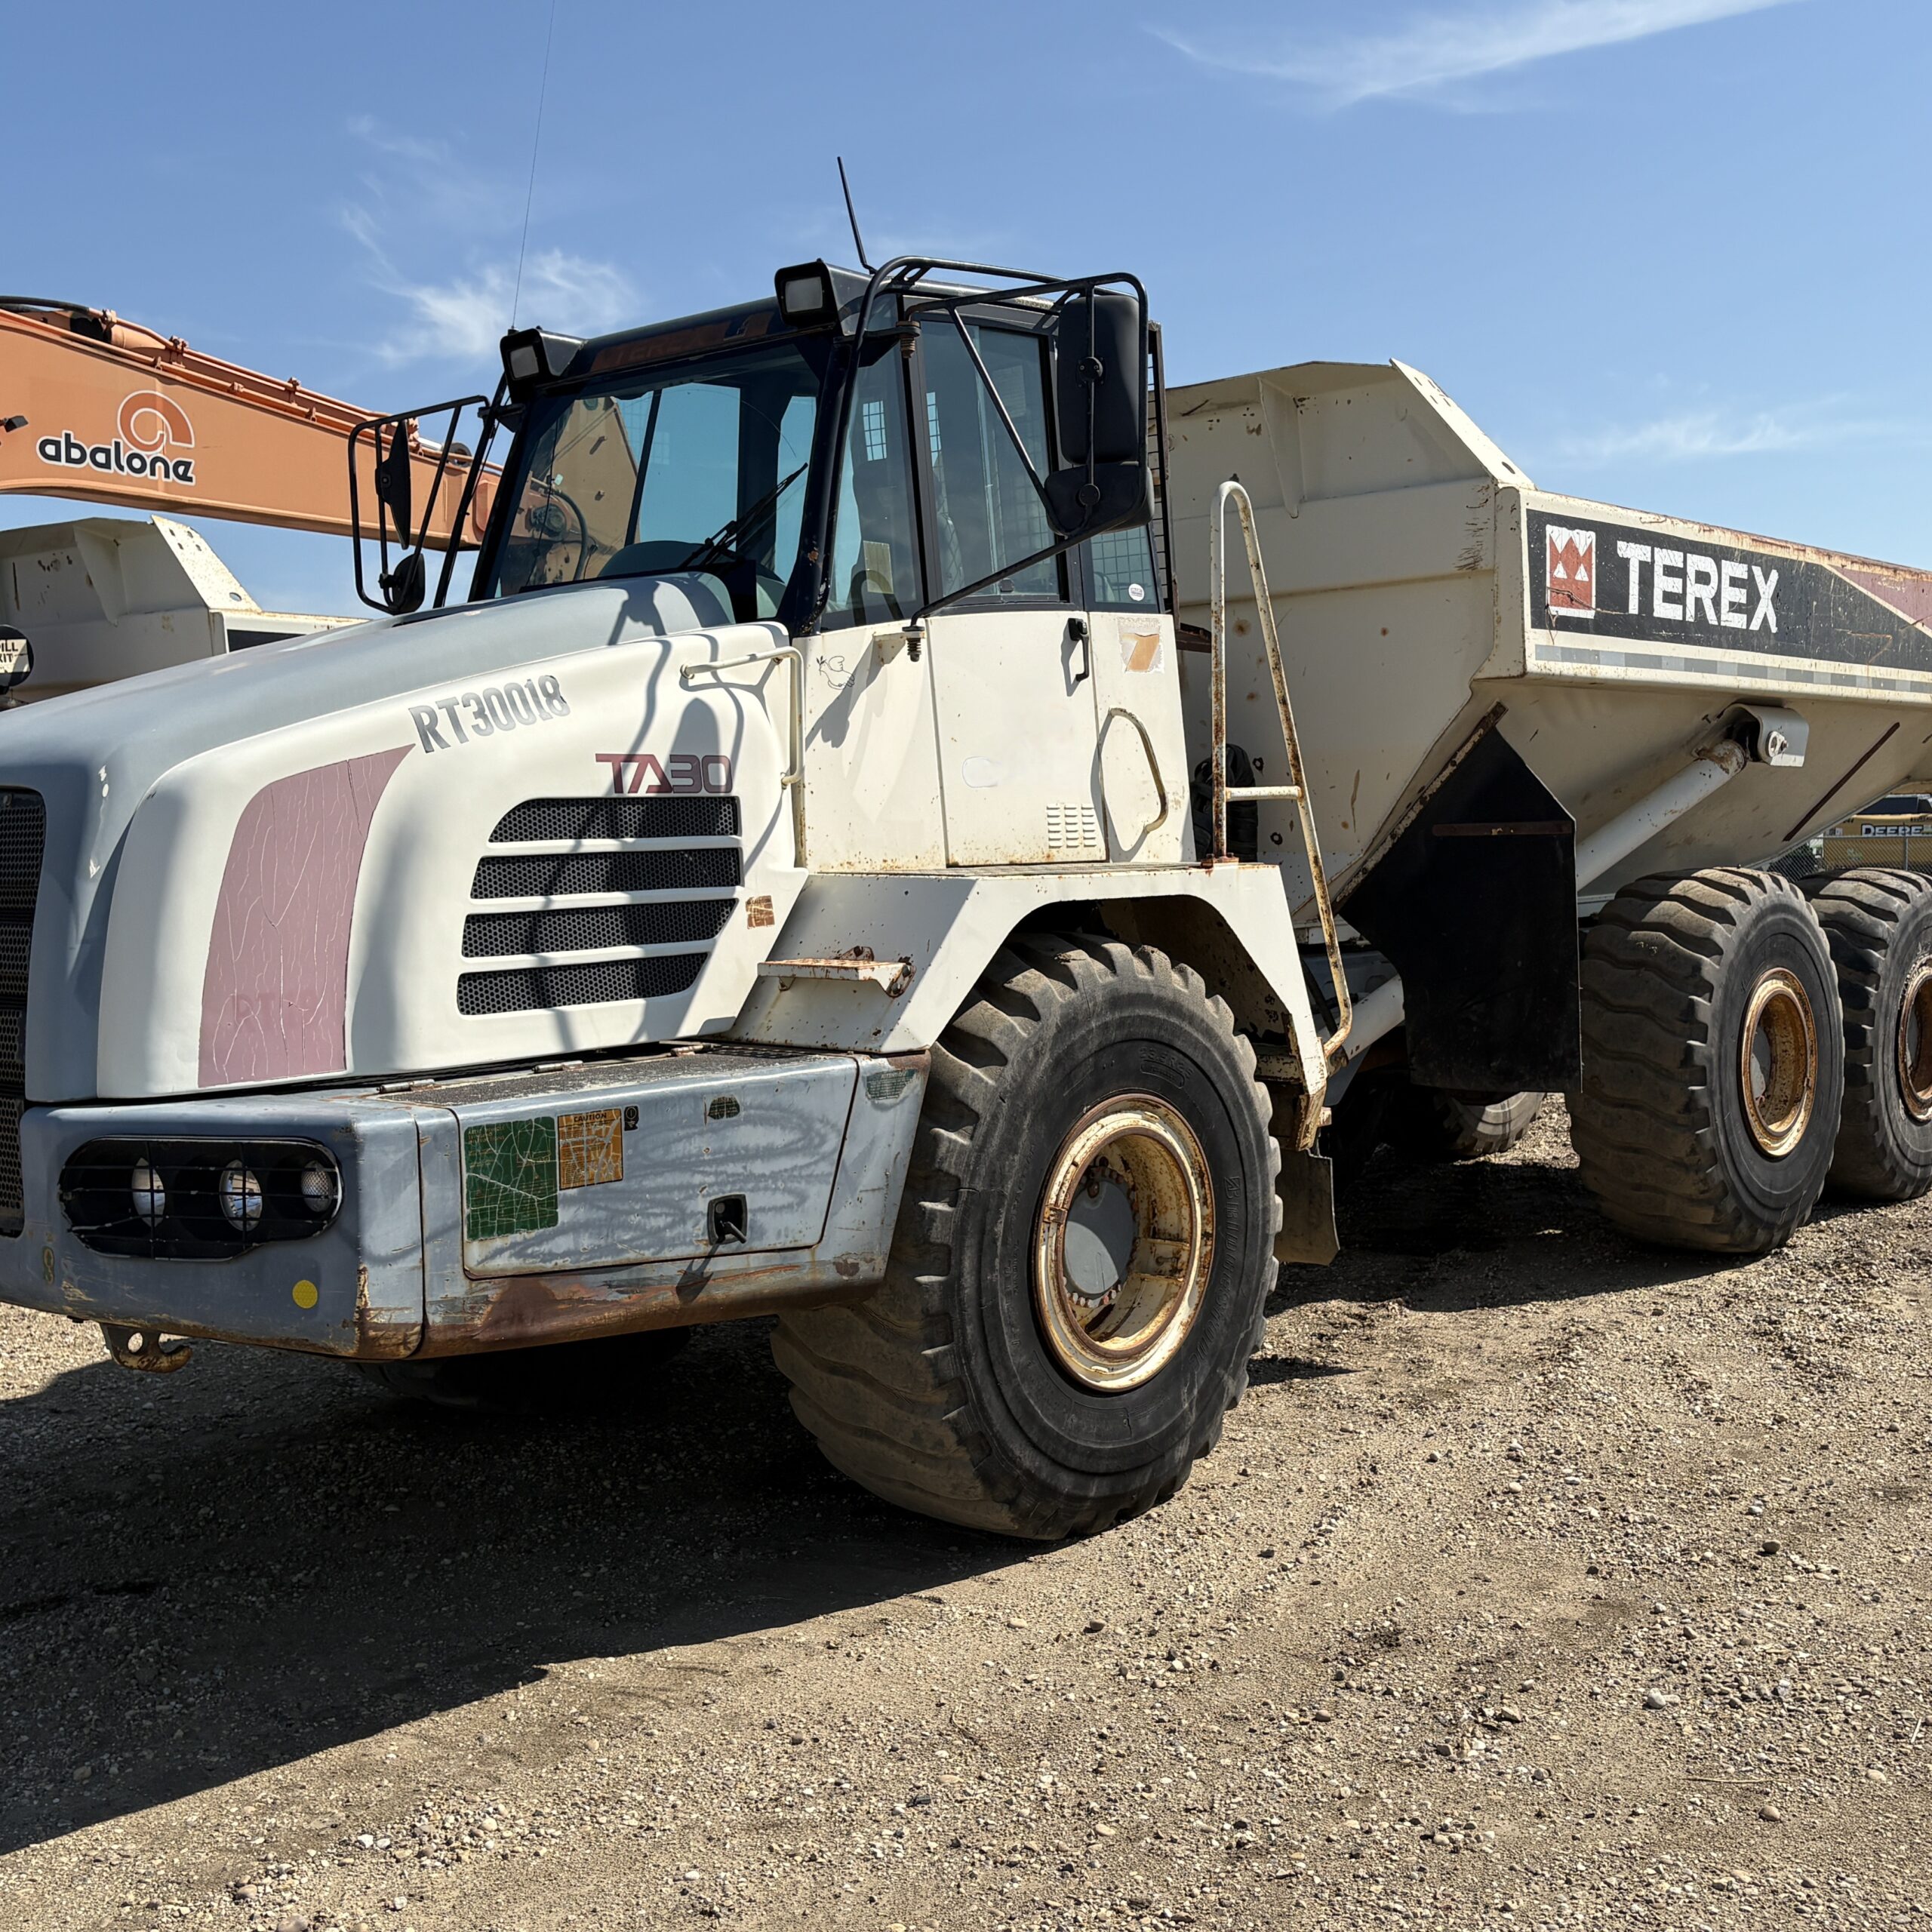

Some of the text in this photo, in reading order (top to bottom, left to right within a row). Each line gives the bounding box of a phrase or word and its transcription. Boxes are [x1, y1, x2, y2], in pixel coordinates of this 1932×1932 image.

[38, 432, 194, 484] abalone
[1617, 540, 1780, 634] TEREX
[0, 641, 19, 652] ILL
[408, 674, 571, 754] RT30018
[595, 753, 734, 794] TA30
[1861, 823, 1923, 837] DEERE
[573, 1112, 608, 1123] CAUTION
